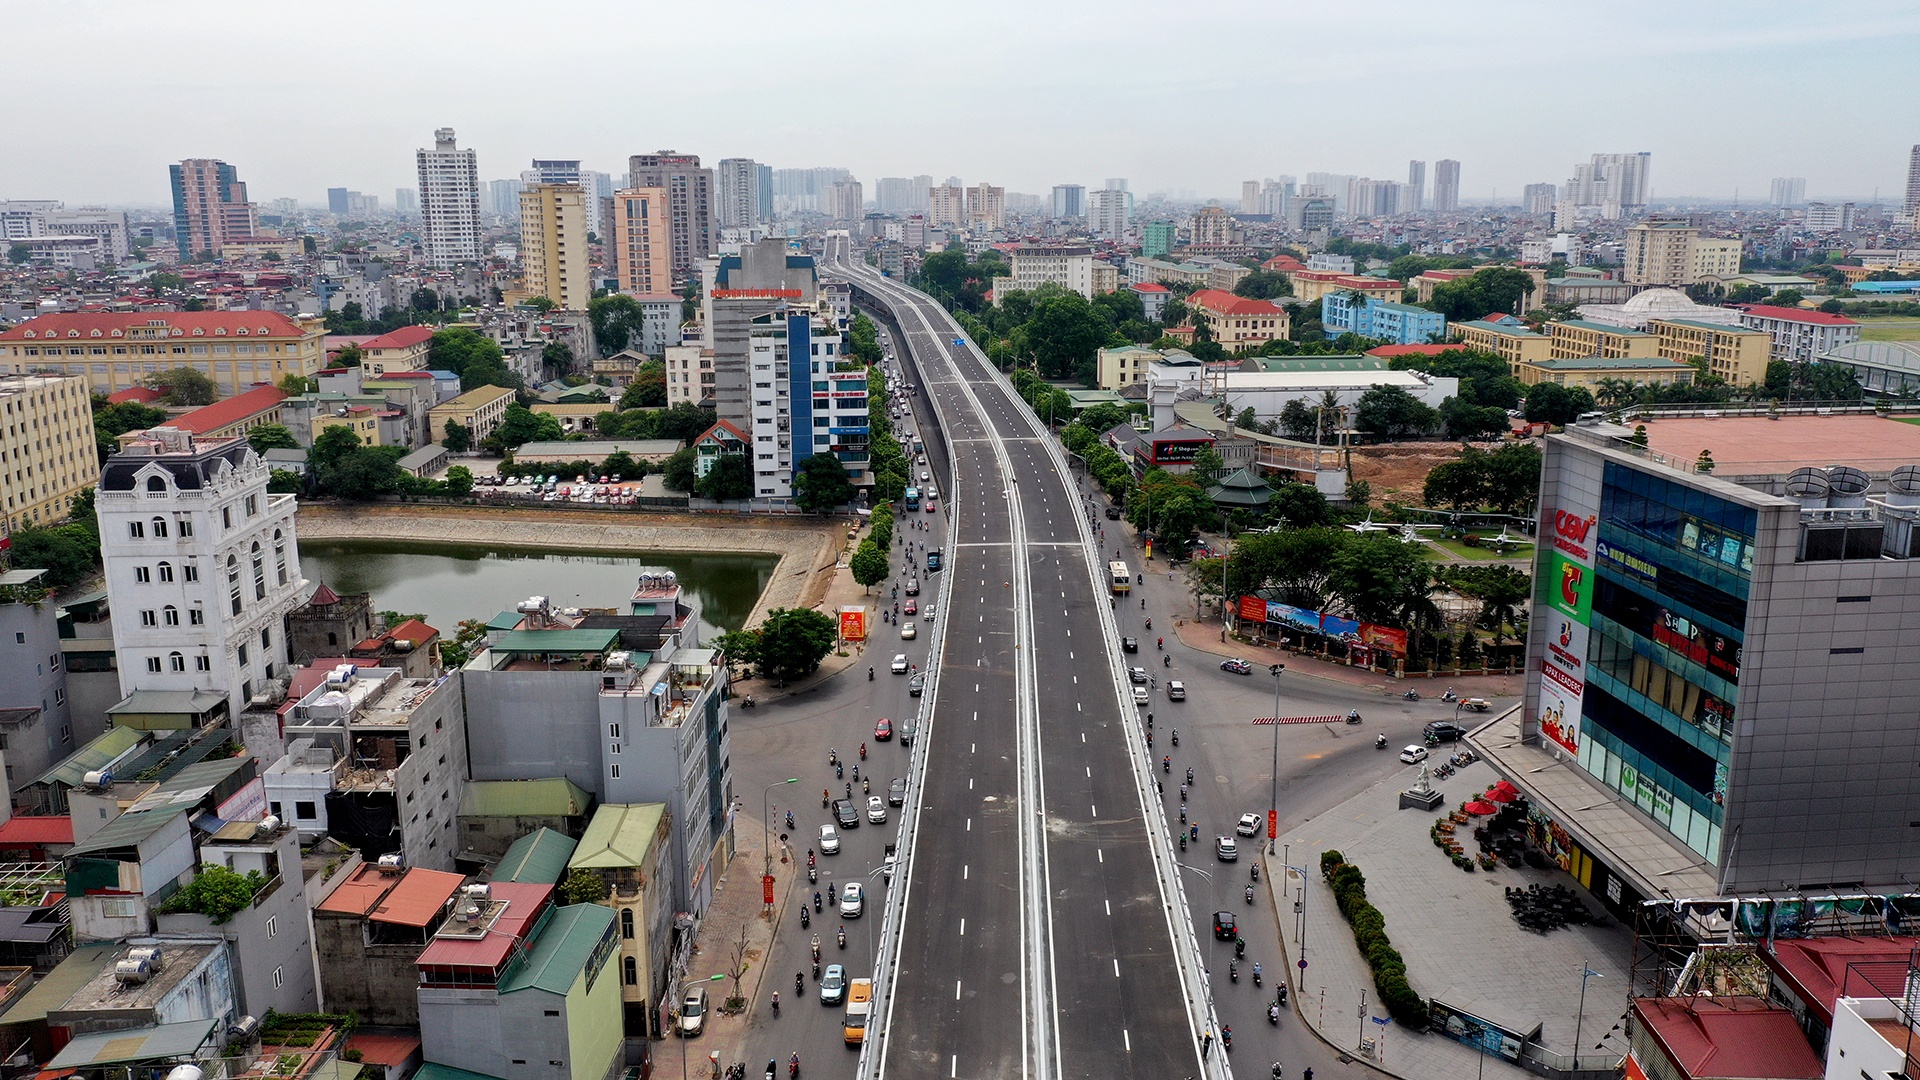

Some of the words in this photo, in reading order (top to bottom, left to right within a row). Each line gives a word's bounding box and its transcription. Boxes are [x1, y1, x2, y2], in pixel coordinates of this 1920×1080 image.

[1163, 444, 1179, 455] FPT
[1555, 509, 1590, 543] CGV
[1561, 561, 1573, 578] Big
[1561, 566, 1582, 607] C
[1545, 664, 1558, 682] APAX
[1558, 672, 1582, 694] LEADERS
